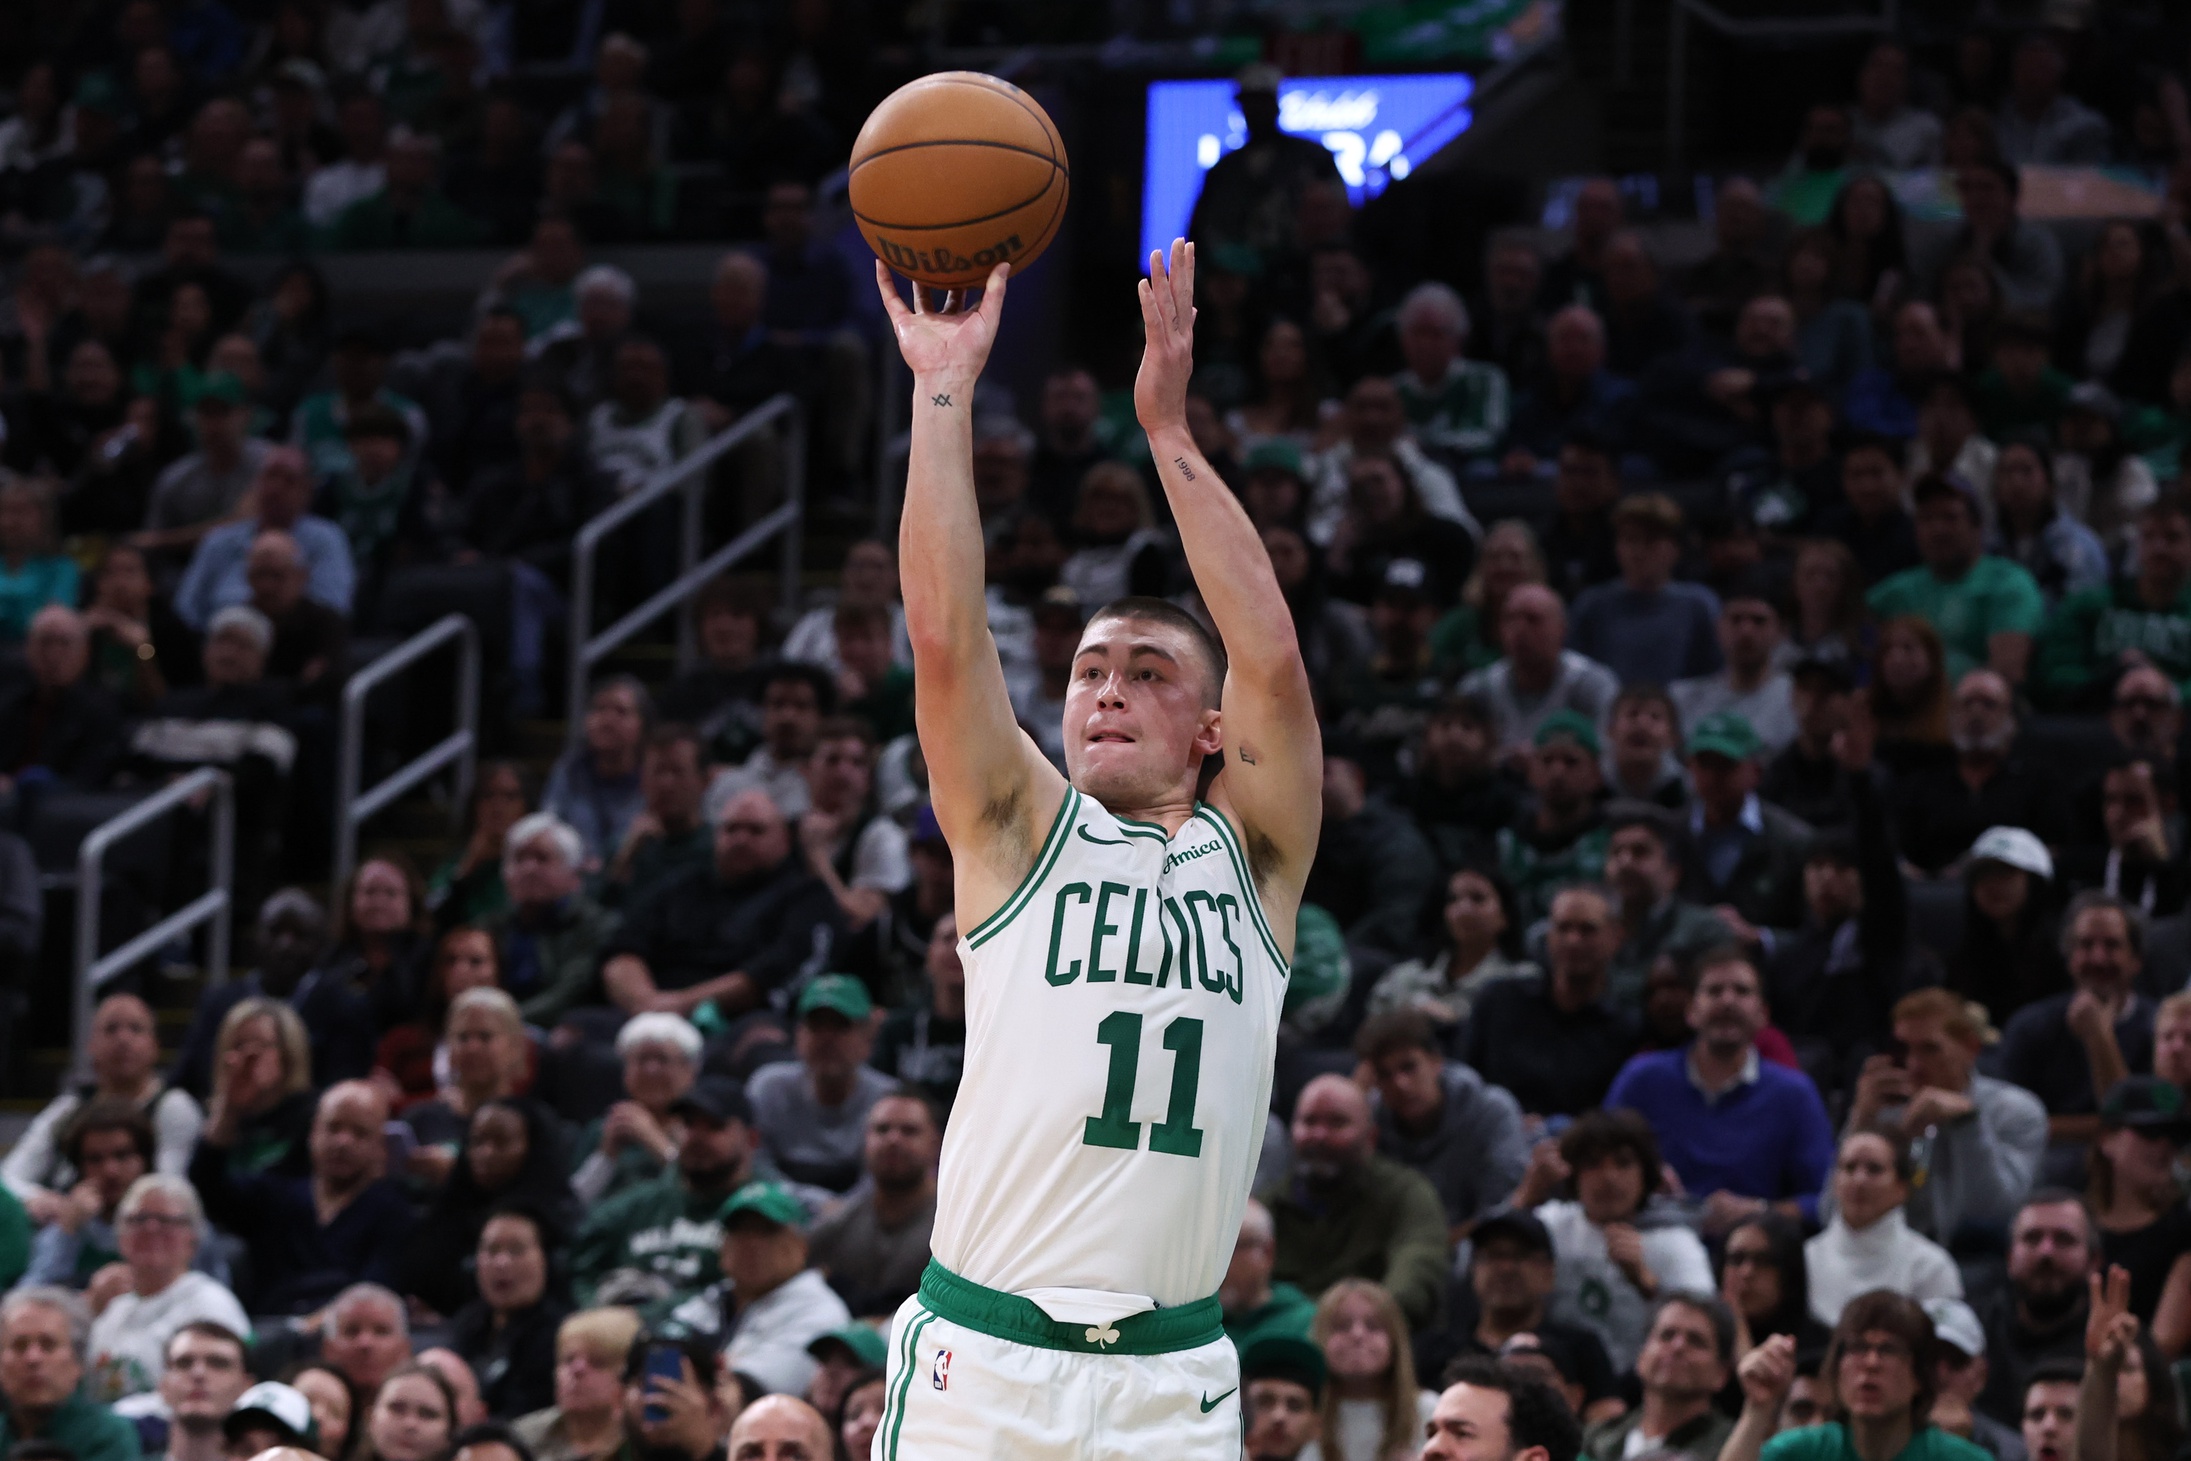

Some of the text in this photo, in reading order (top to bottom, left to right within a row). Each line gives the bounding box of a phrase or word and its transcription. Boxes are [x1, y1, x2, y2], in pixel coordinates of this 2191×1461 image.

[875, 232, 1024, 274] Wilson
[1174, 456, 1196, 482] 1998
[1163, 839, 1223, 875] Amica
[1082, 1010, 1204, 1158] 11
